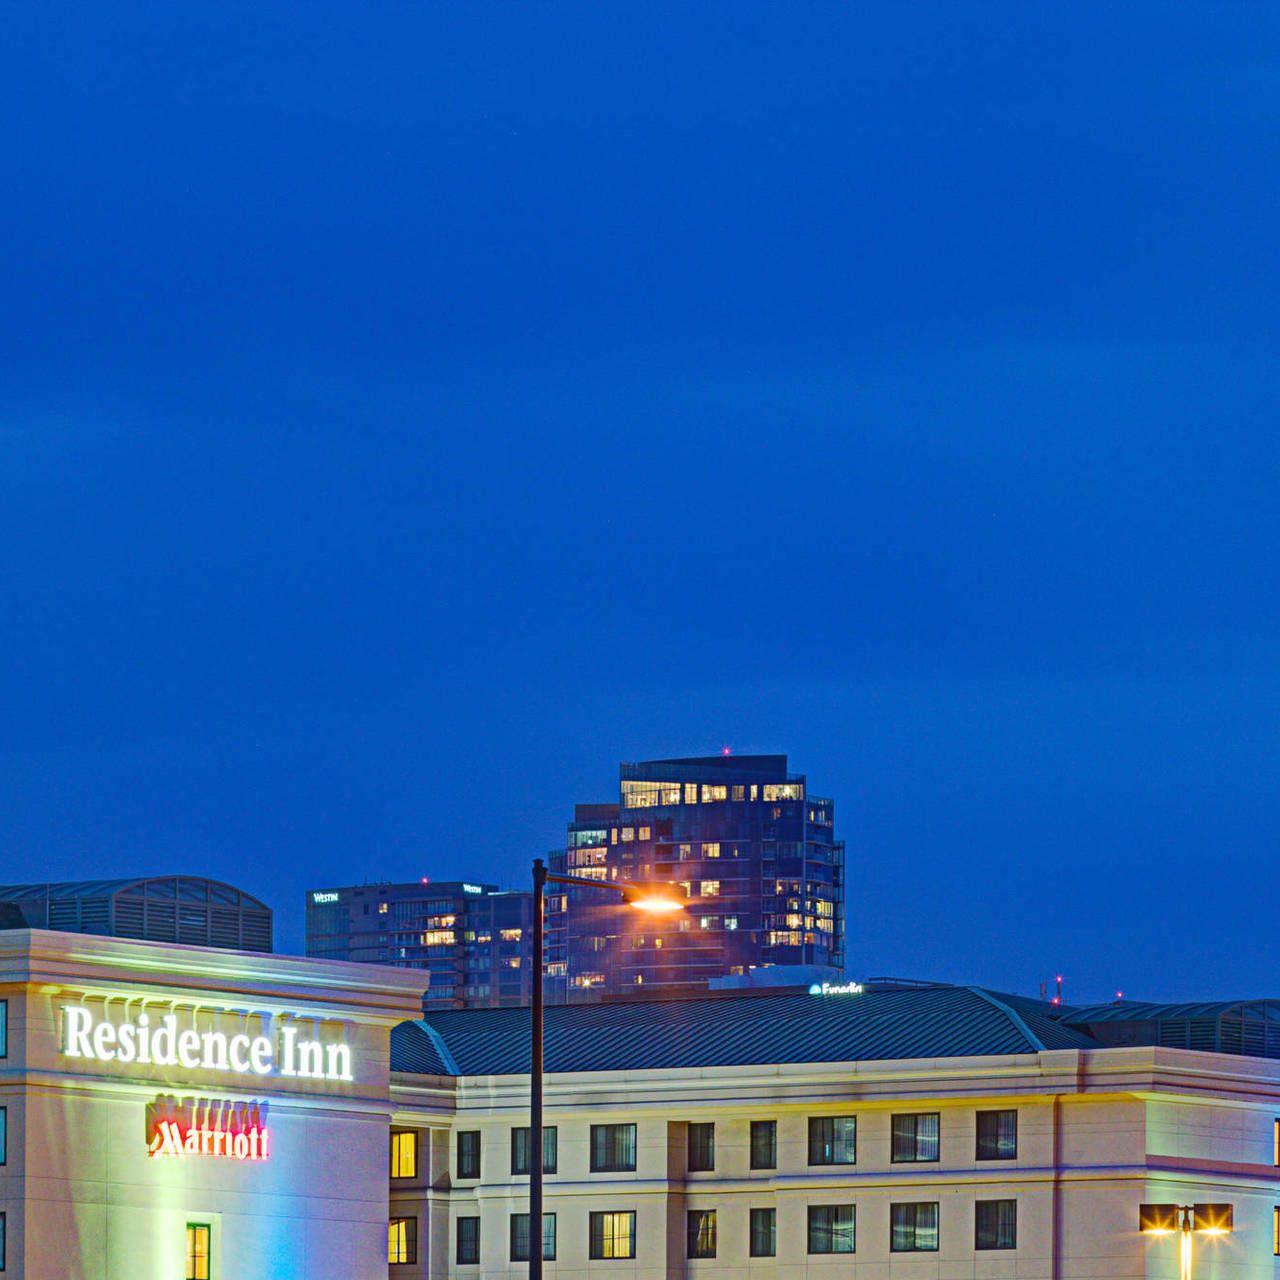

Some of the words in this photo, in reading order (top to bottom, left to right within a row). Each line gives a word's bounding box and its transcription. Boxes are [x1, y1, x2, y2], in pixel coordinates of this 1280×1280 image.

[62, 1004, 273, 1075] Residence
[280, 1025, 354, 1081] Inn
[147, 1121, 270, 1161] Marriott
